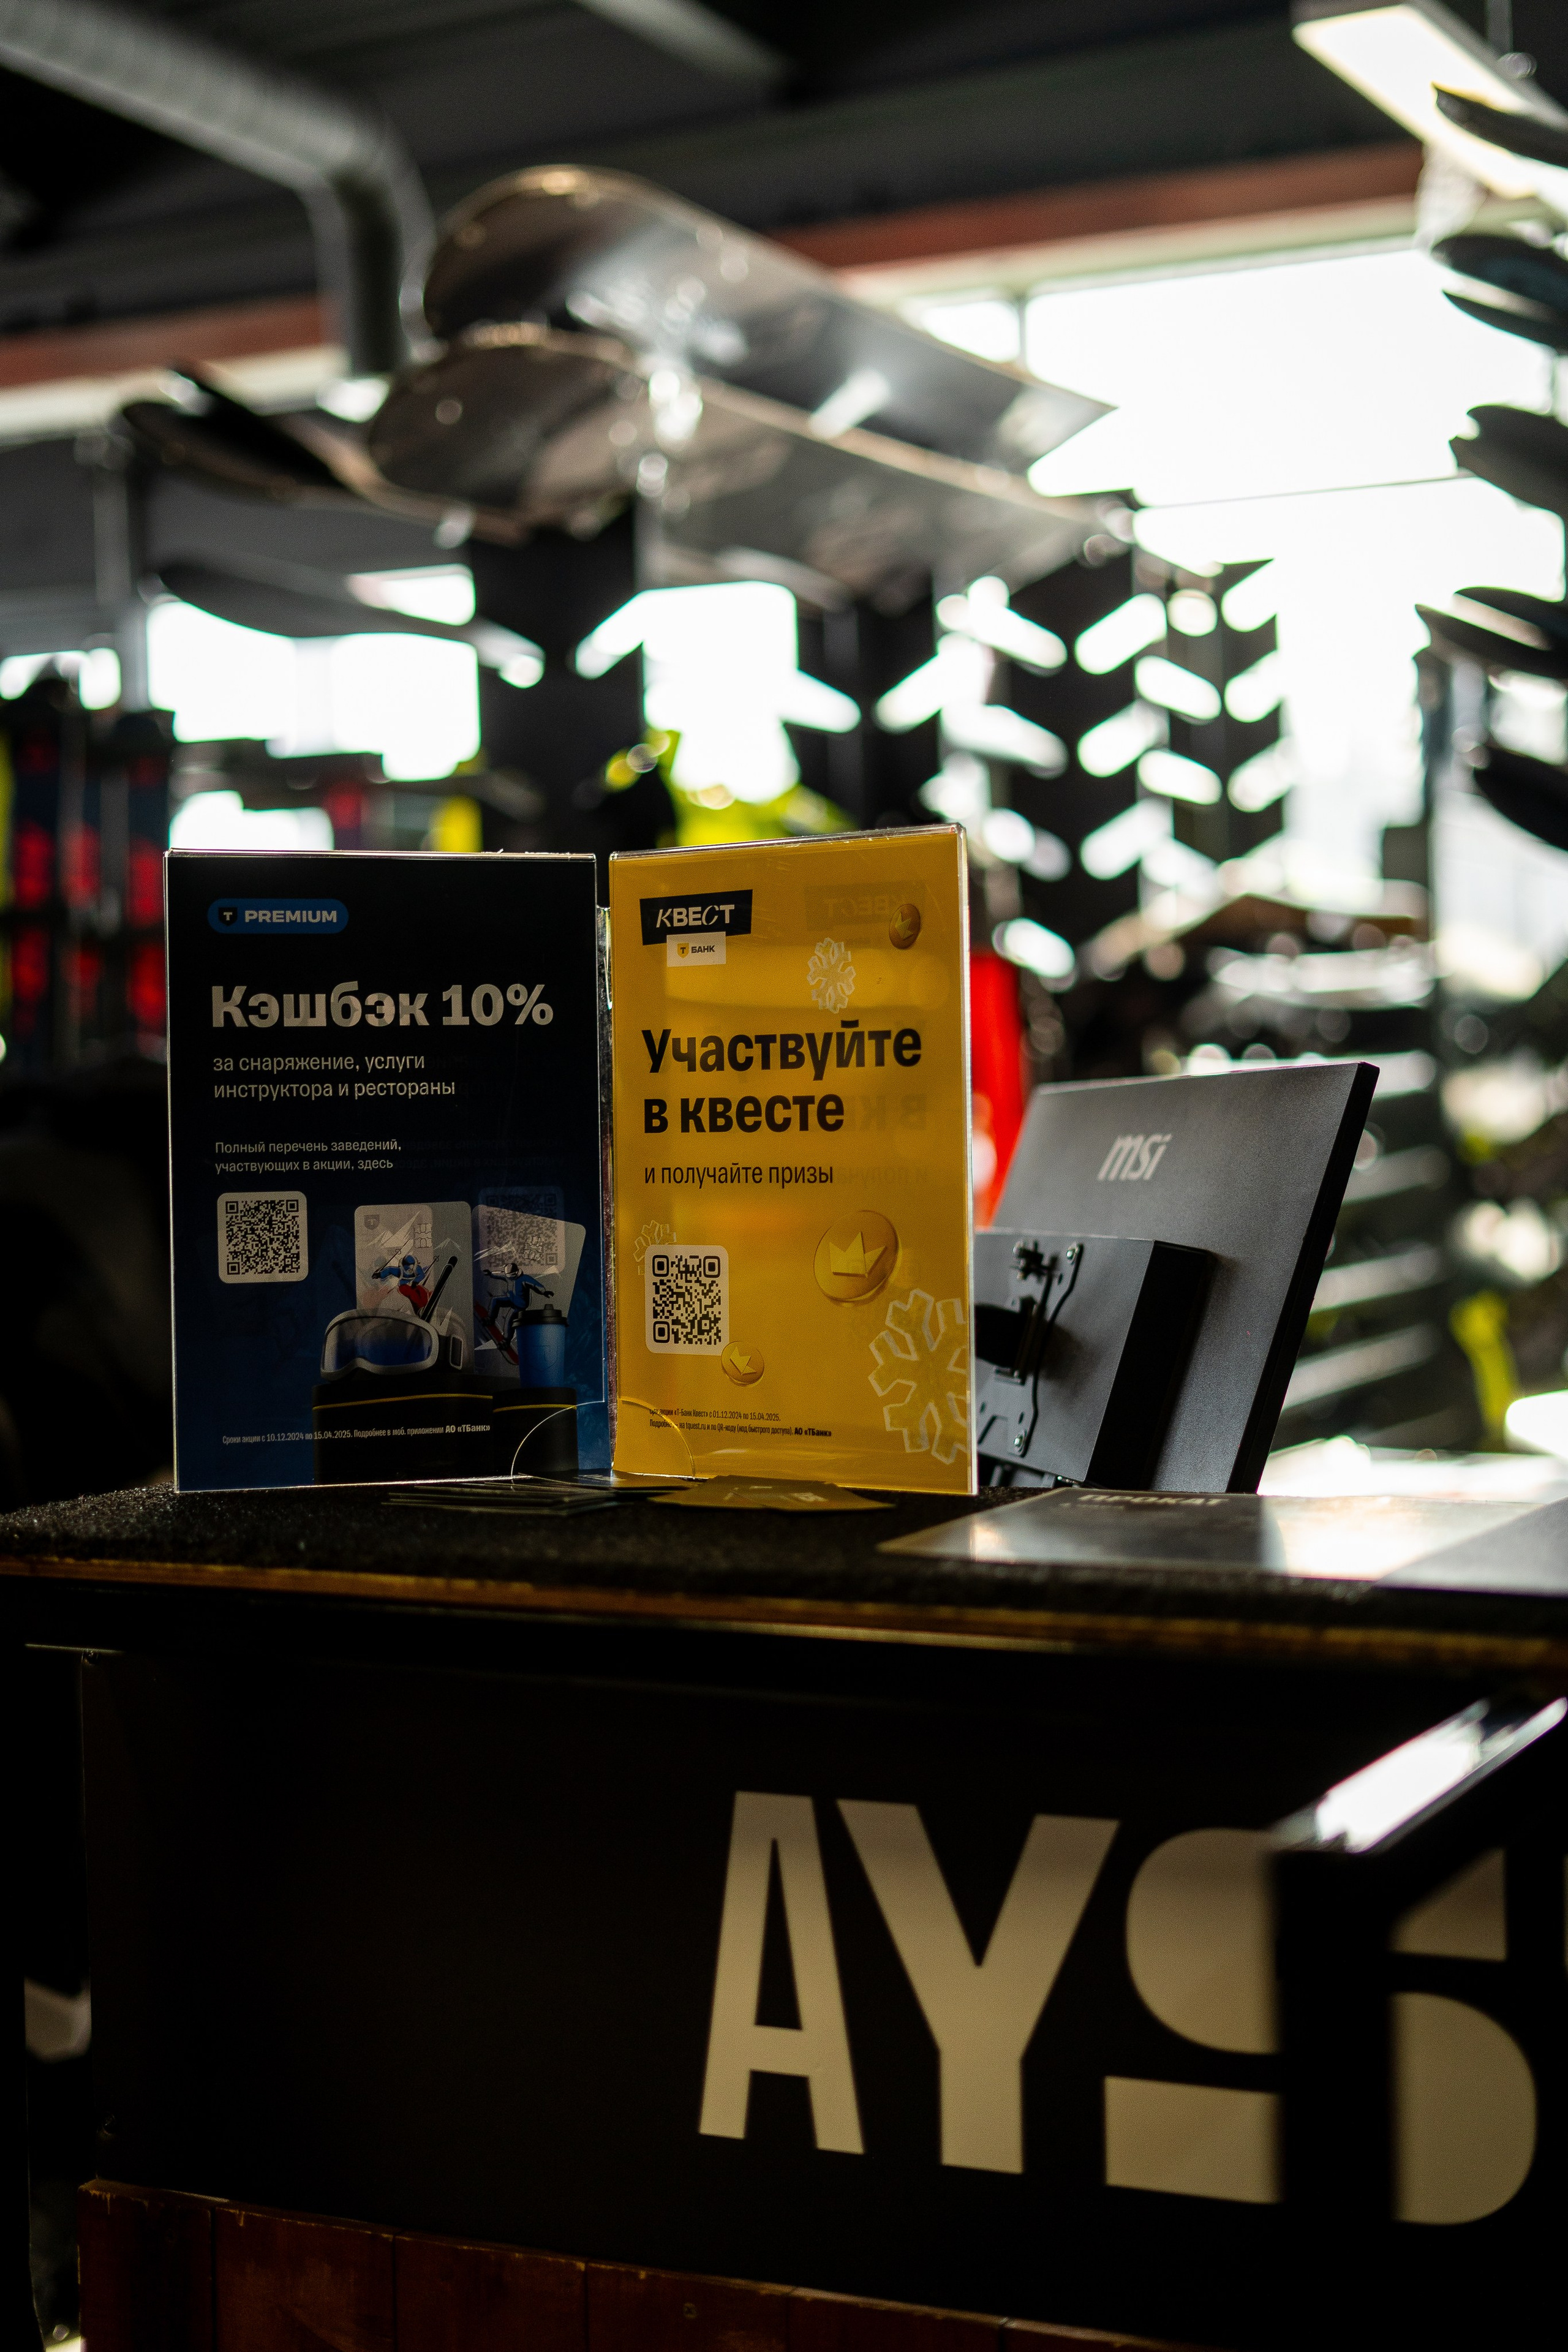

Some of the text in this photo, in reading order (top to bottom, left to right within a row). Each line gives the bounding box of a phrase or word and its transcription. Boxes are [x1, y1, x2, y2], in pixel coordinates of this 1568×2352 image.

[245, 910, 337, 923] PREMIUM
[656, 905, 734, 928] КВЕСТ
[691, 944, 715, 954] БАНК
[212, 981, 553, 1028] Кэшбэк 10%
[641, 1020, 922, 1081] Участвуйте
[214, 1058, 233, 1071] за
[239, 1056, 360, 1074] снаряжение,
[364, 1055, 425, 1073] услуги
[214, 1083, 333, 1101] инструктора
[338, 1083, 349, 1096] и
[354, 1080, 455, 1100] рестораны
[644, 1098, 668, 1134] в
[680, 1094, 845, 1133] квесте
[216, 1138, 402, 1155] Полный перечень заведений,
[1097, 1133, 1172, 1181] msi
[215, 1158, 393, 1175] участвующих в акции, здесь
[644, 1167, 655, 1184] и
[661, 1163, 763, 1189] получайте
[769, 1165, 833, 1189] призы
[713, 1411, 742, 1419] 01.12.2024
[750, 1412, 781, 1421] 15.04.2025.
[223, 1435, 241, 1446] Сроки
[266, 1432, 304, 1442] 10.12.2024
[314, 1430, 353, 1439] 15.04.2025.
[353, 1428, 386, 1439] Подробнее
[393, 1427, 406, 1436] моб.
[407, 1427, 444, 1437] приложении
[445, 1425, 456, 1433] АО
[458, 1424, 491, 1433] «ТБанк»
[748, 1424, 771, 1434] быстрого
